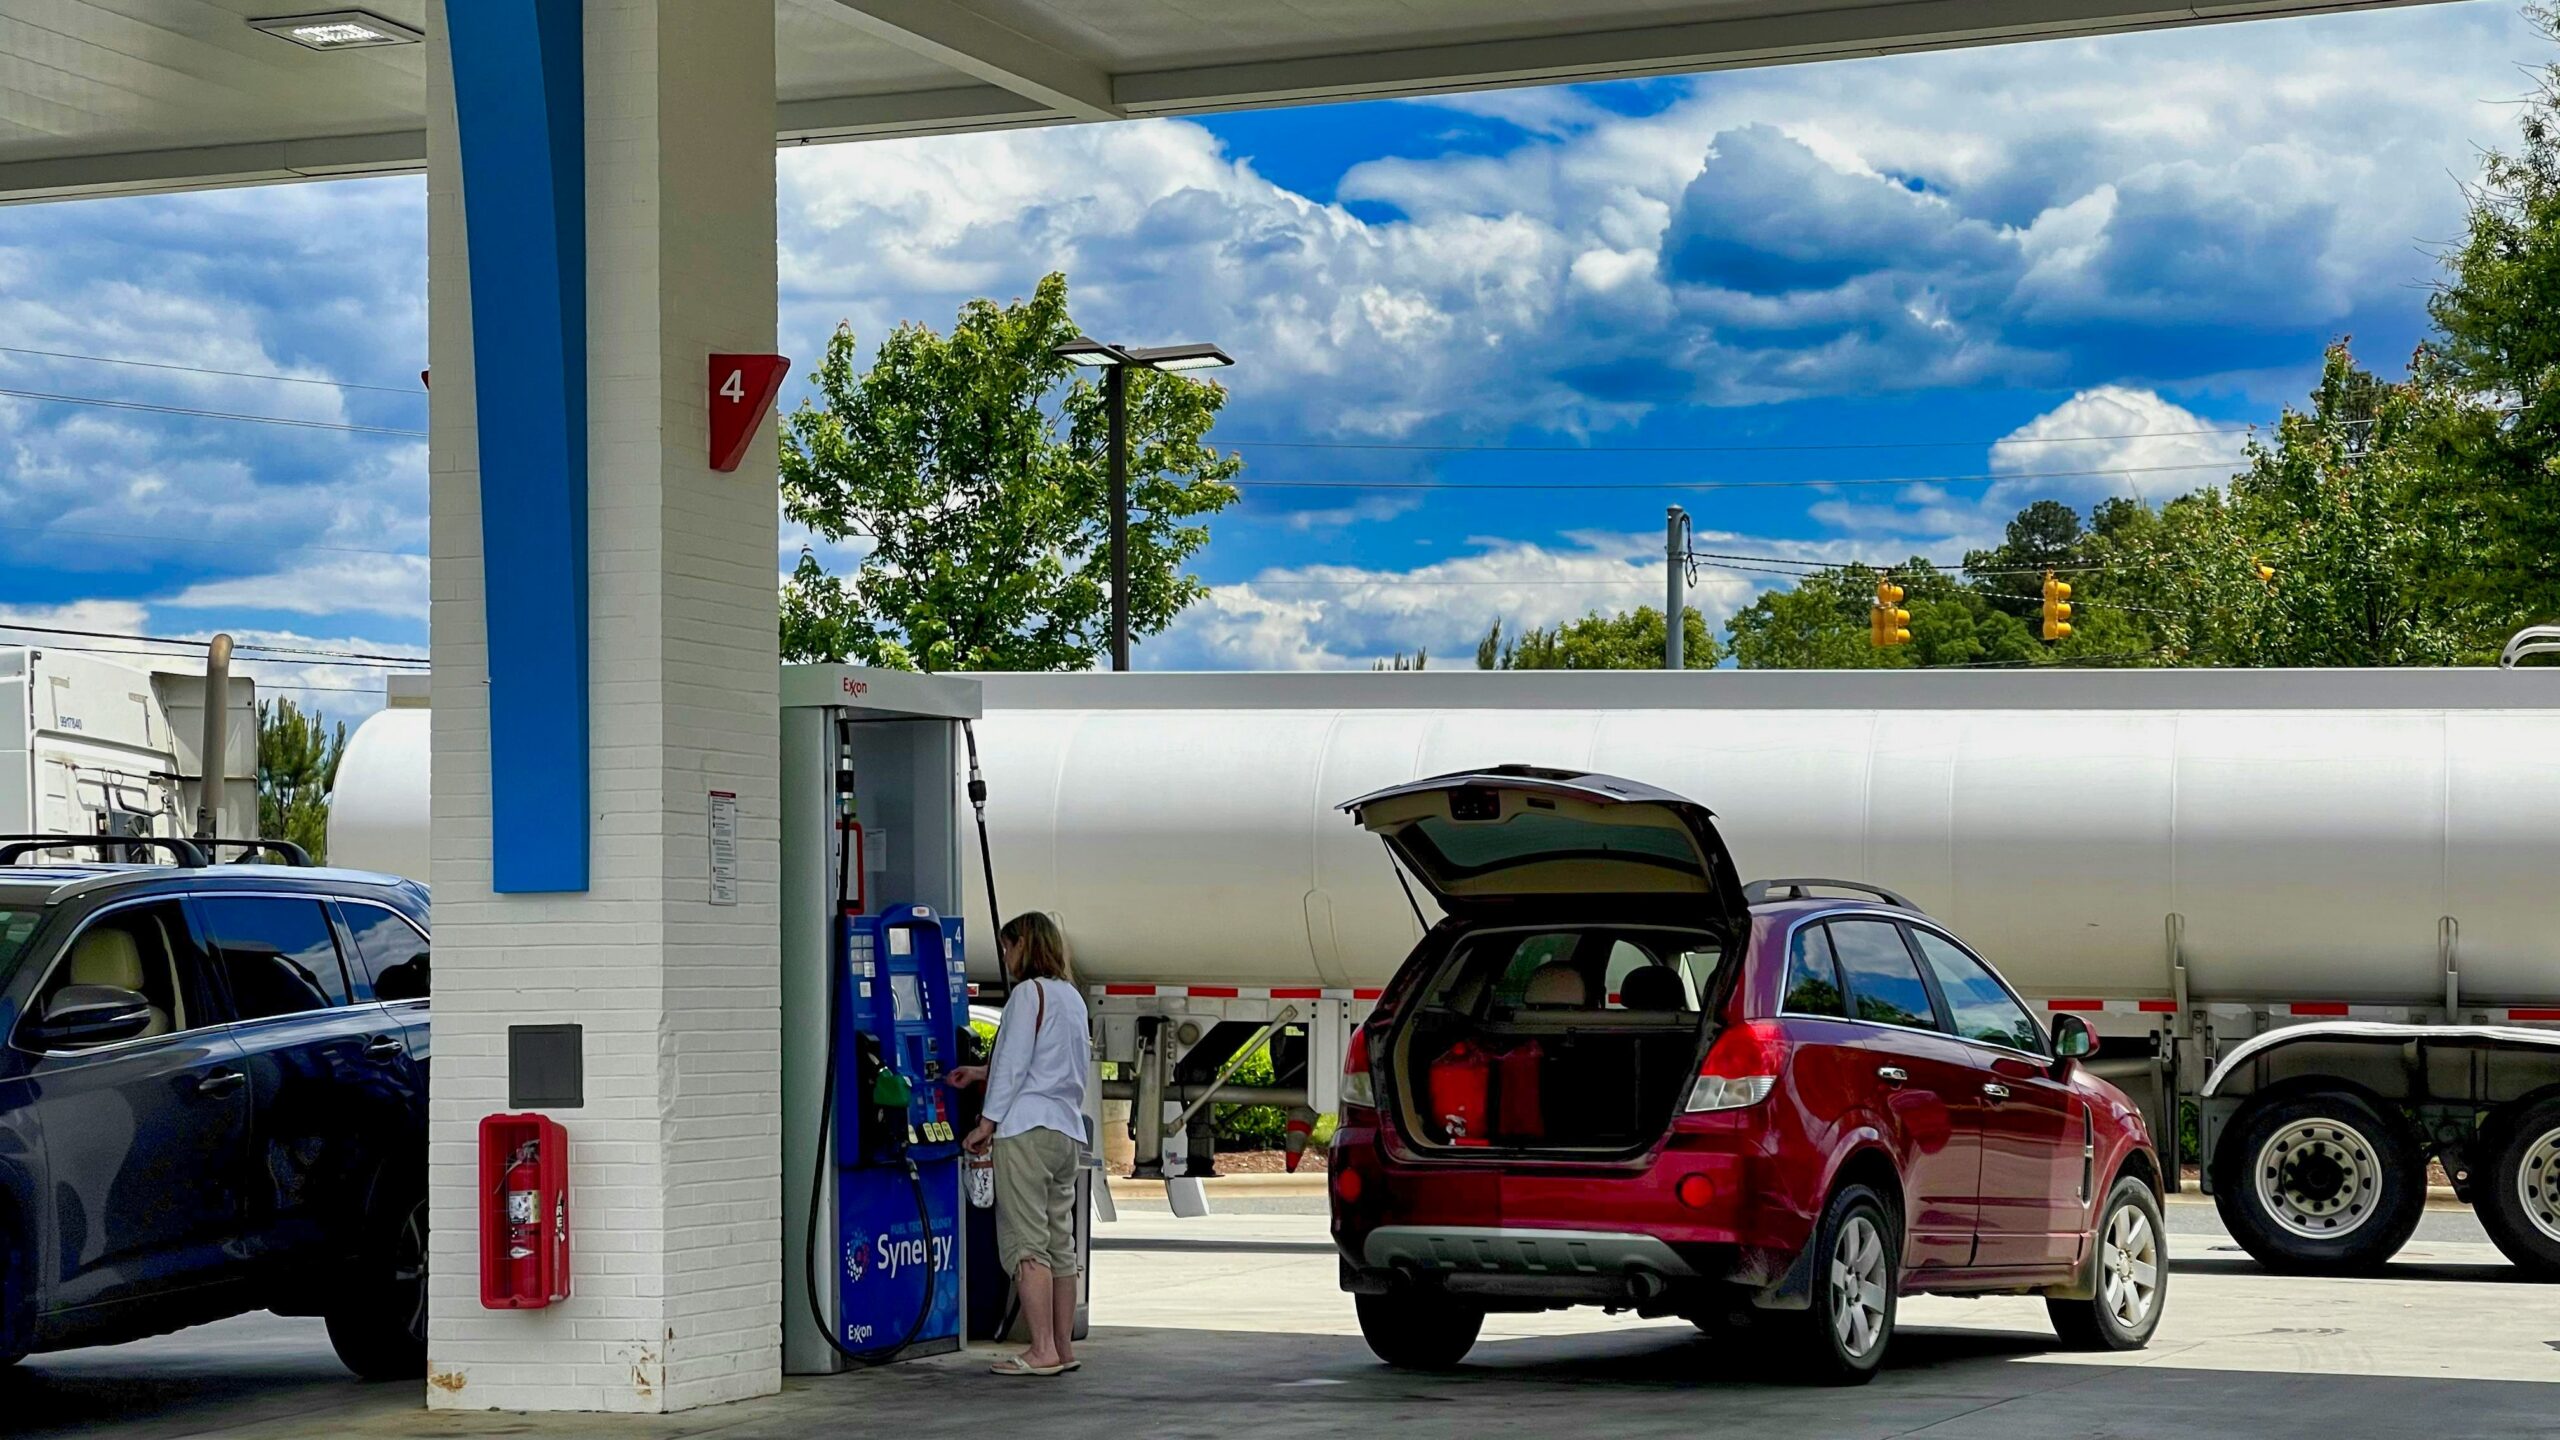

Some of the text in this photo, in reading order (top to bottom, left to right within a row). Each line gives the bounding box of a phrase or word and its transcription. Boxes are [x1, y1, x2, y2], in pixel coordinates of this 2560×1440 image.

[719, 369, 745, 404] 4
[843, 677, 868, 698] Exxon
[955, 925, 962, 944] 4
[891, 1223, 906, 1234] FUEL
[848, 1324, 872, 1344] Exxon
